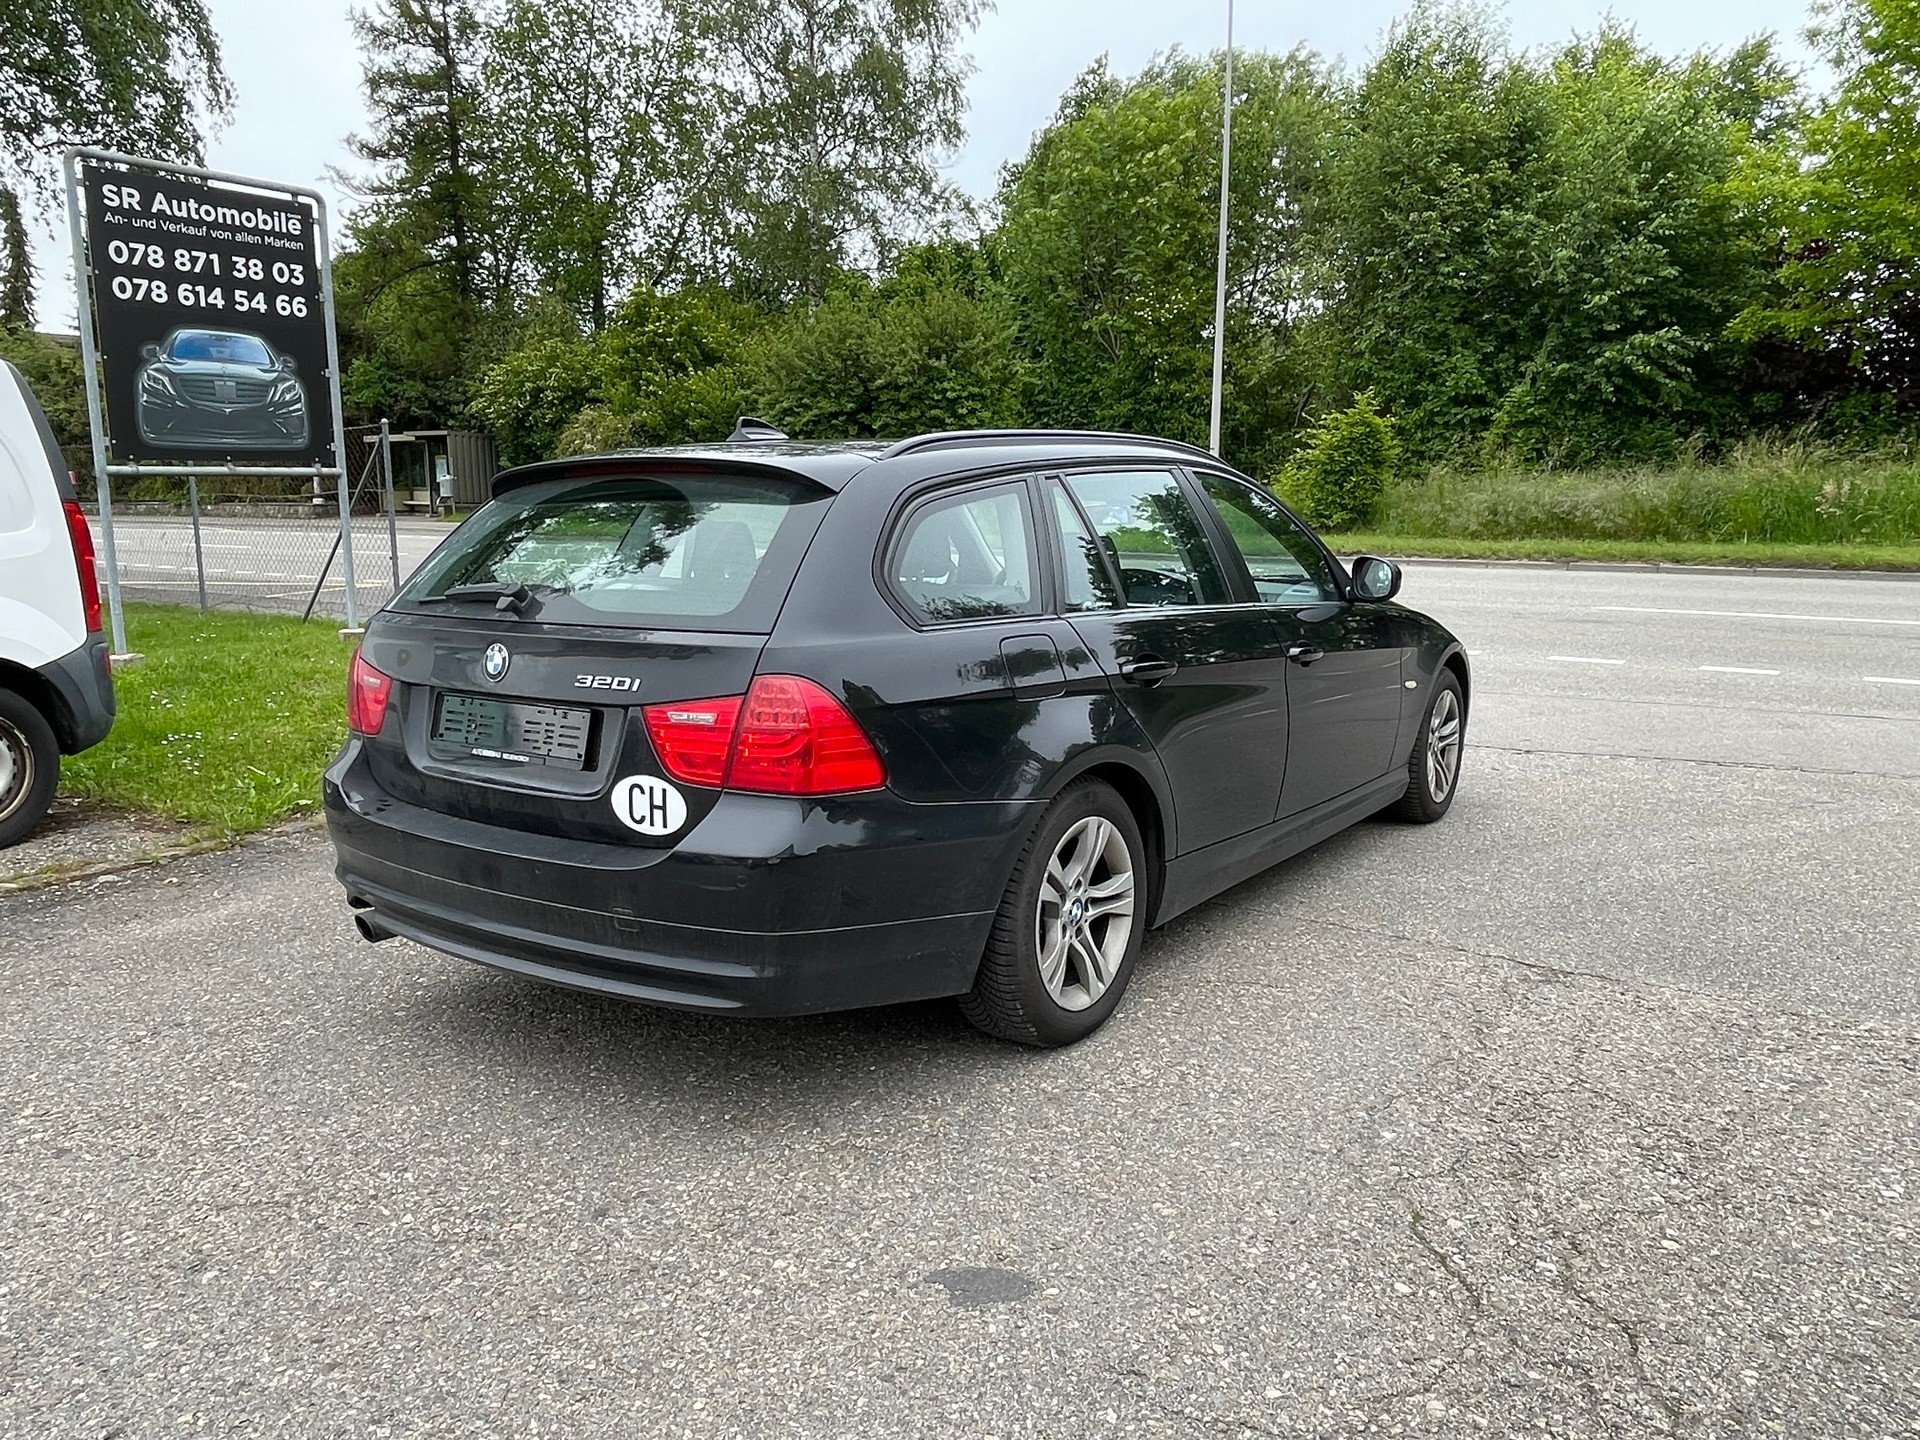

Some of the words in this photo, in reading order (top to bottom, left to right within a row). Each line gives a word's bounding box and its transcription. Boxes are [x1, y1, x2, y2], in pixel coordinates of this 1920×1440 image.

[102, 184, 142, 211] SR
[151, 192, 302, 235] Automobile
[104, 211, 129, 224] An-
[132, 217, 157, 230] und
[160, 219, 207, 237] Verkauf
[210, 229, 232, 241] von
[235, 231, 262, 245] allen
[264, 235, 304, 251] Marken
[108, 240, 165, 269] 078
[174, 248, 221, 276] 871
[231, 255, 265, 281] 38
[272, 261, 305, 286] 03
[112, 276, 169, 304] 078
[177, 283, 226, 310] 614
[234, 289, 268, 314] 54
[275, 294, 308, 318] 66
[628, 783, 668, 829] CH
